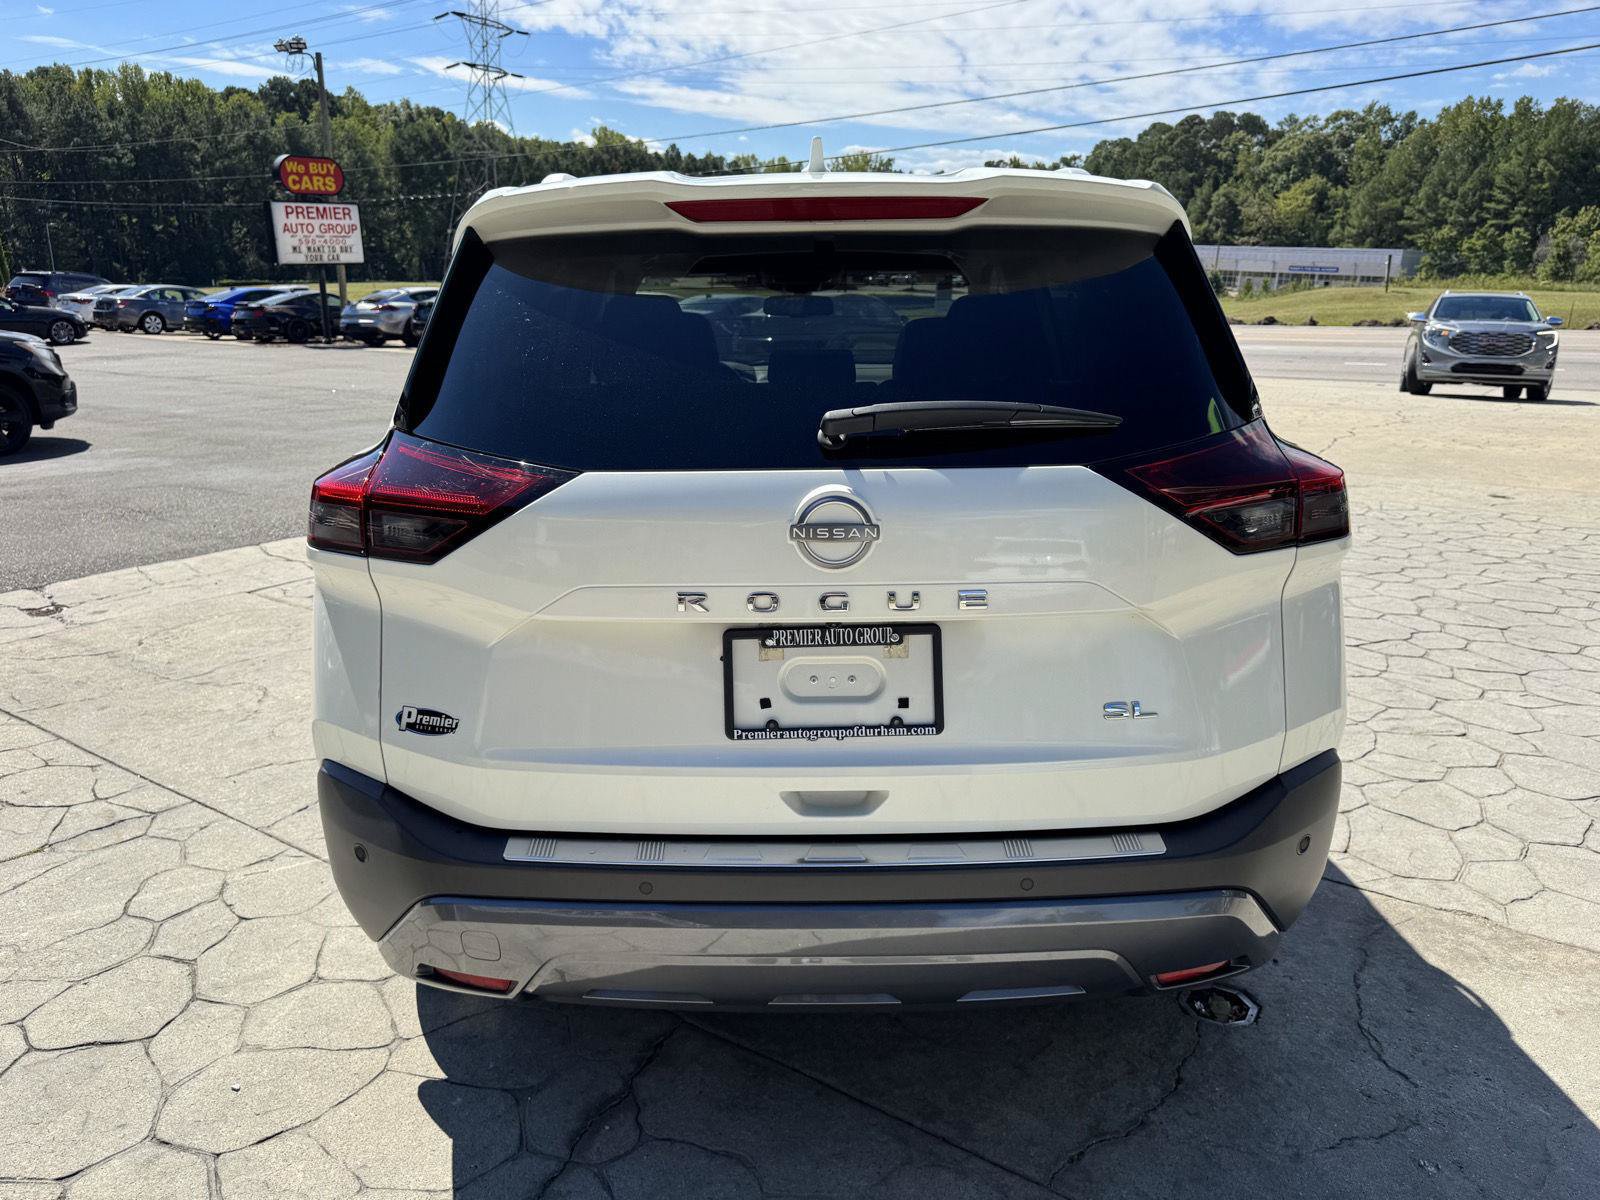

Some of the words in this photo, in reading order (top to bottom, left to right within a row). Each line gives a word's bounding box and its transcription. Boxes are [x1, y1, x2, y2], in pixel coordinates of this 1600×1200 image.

[285, 161, 305, 173] We
[309, 162, 336, 174] BUY
[288, 175, 336, 191] CARS
[284, 205, 352, 220] PREMIER
[282, 223, 315, 234] AUTO
[319, 223, 358, 235] GROUP
[792, 527, 878, 539] NISSAN
[676, 589, 989, 613] ROGUE
[773, 629, 823, 647] PREMIER
[824, 628, 852, 645] AUTO
[855, 627, 894, 645] GROUP
[399, 705, 460, 732] Premier
[1103, 701, 1159, 721] SL
[733, 725, 937, 741] Premierautogroupofdurham.com
